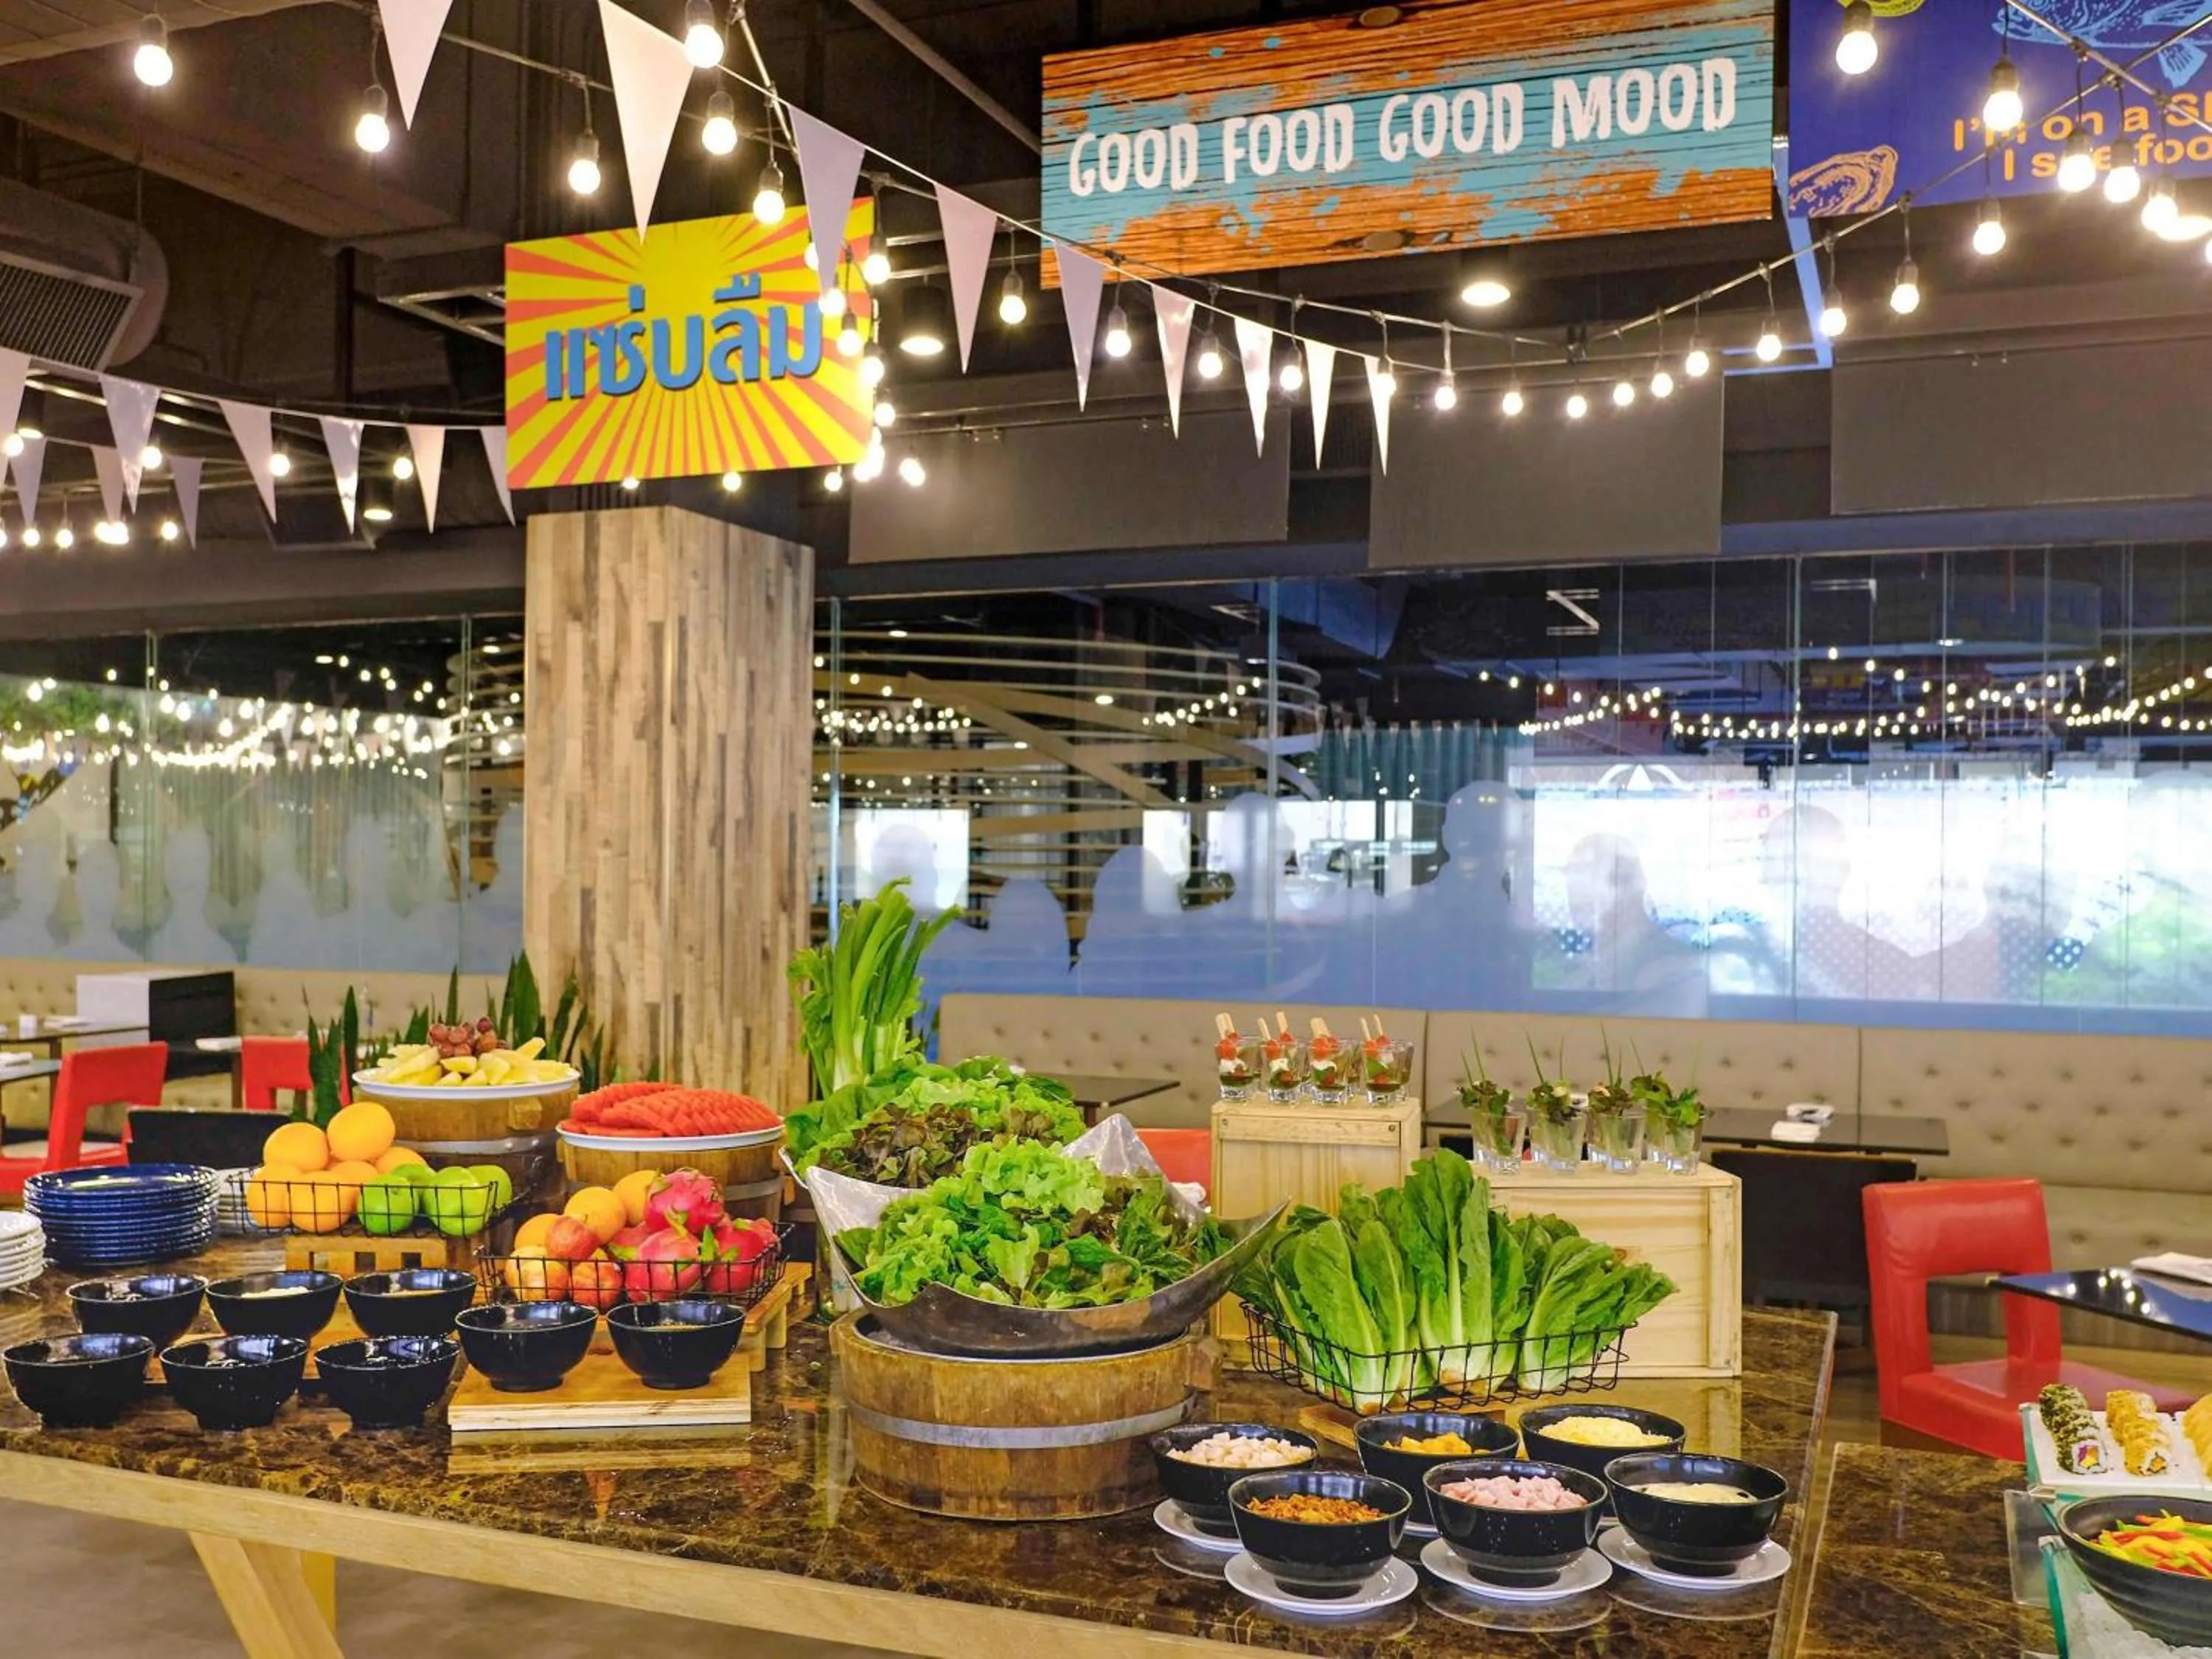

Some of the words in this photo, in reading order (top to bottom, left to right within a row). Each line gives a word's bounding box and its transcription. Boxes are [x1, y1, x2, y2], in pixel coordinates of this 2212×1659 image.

[1068, 121, 1199, 198] GOOD
[1222, 102, 1355, 184] FOOD
[1379, 82, 1524, 163] GOOD
[1551, 57, 1737, 147] MOOD
[2003, 148, 2014, 181] I
[2031, 145, 2115, 178] se
[2042, 111, 2104, 141] on
[2123, 105, 2149, 133] a
[545, 273, 824, 401] แซ่บลืม
